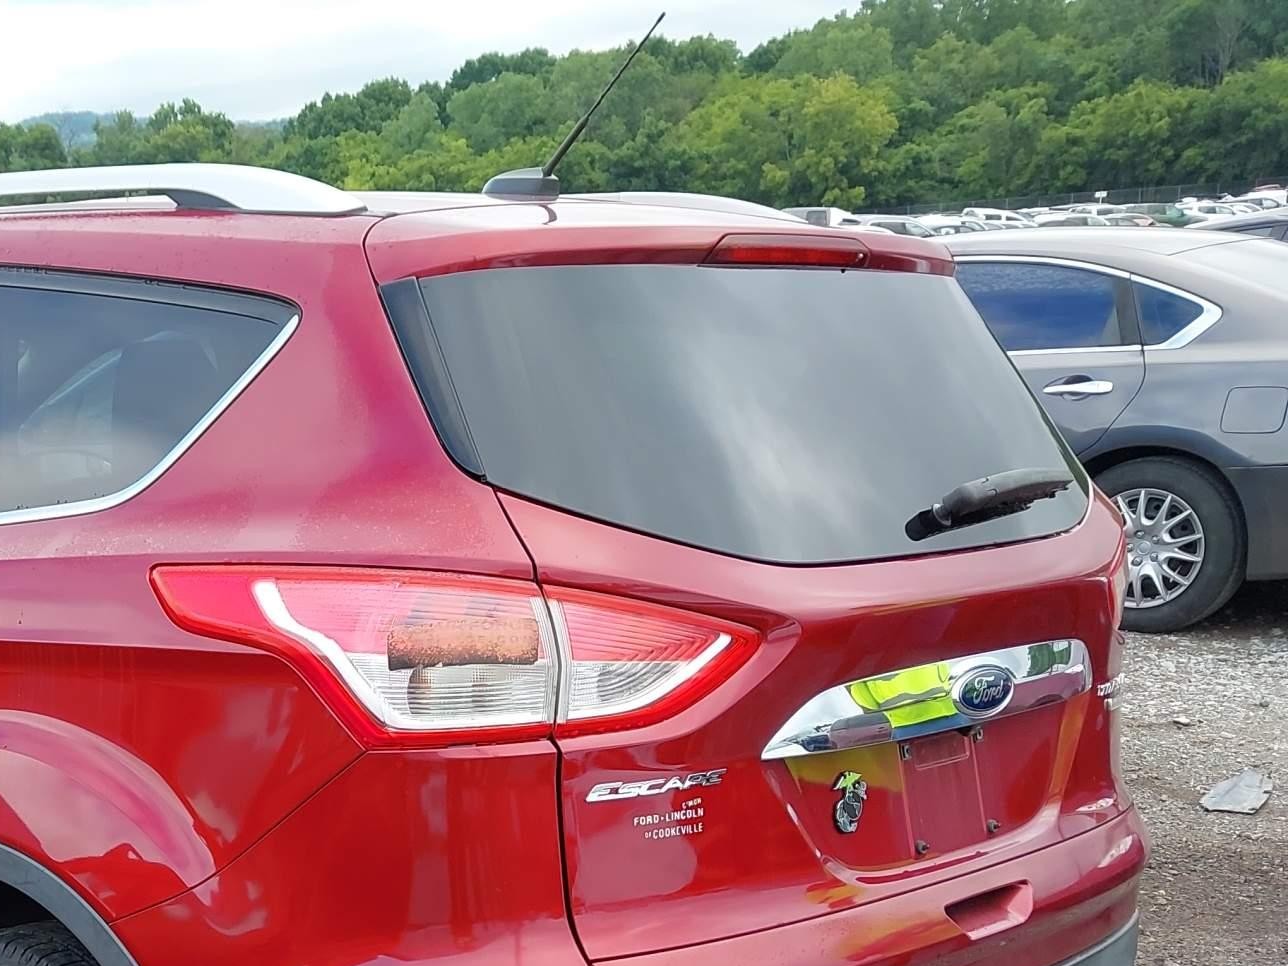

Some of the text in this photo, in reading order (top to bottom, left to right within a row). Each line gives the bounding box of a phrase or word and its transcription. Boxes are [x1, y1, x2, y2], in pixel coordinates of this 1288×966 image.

[973, 675, 1004, 705] Ford
[585, 768, 728, 803] ESCAPE
[652, 822, 704, 840] COOKEVILLE
